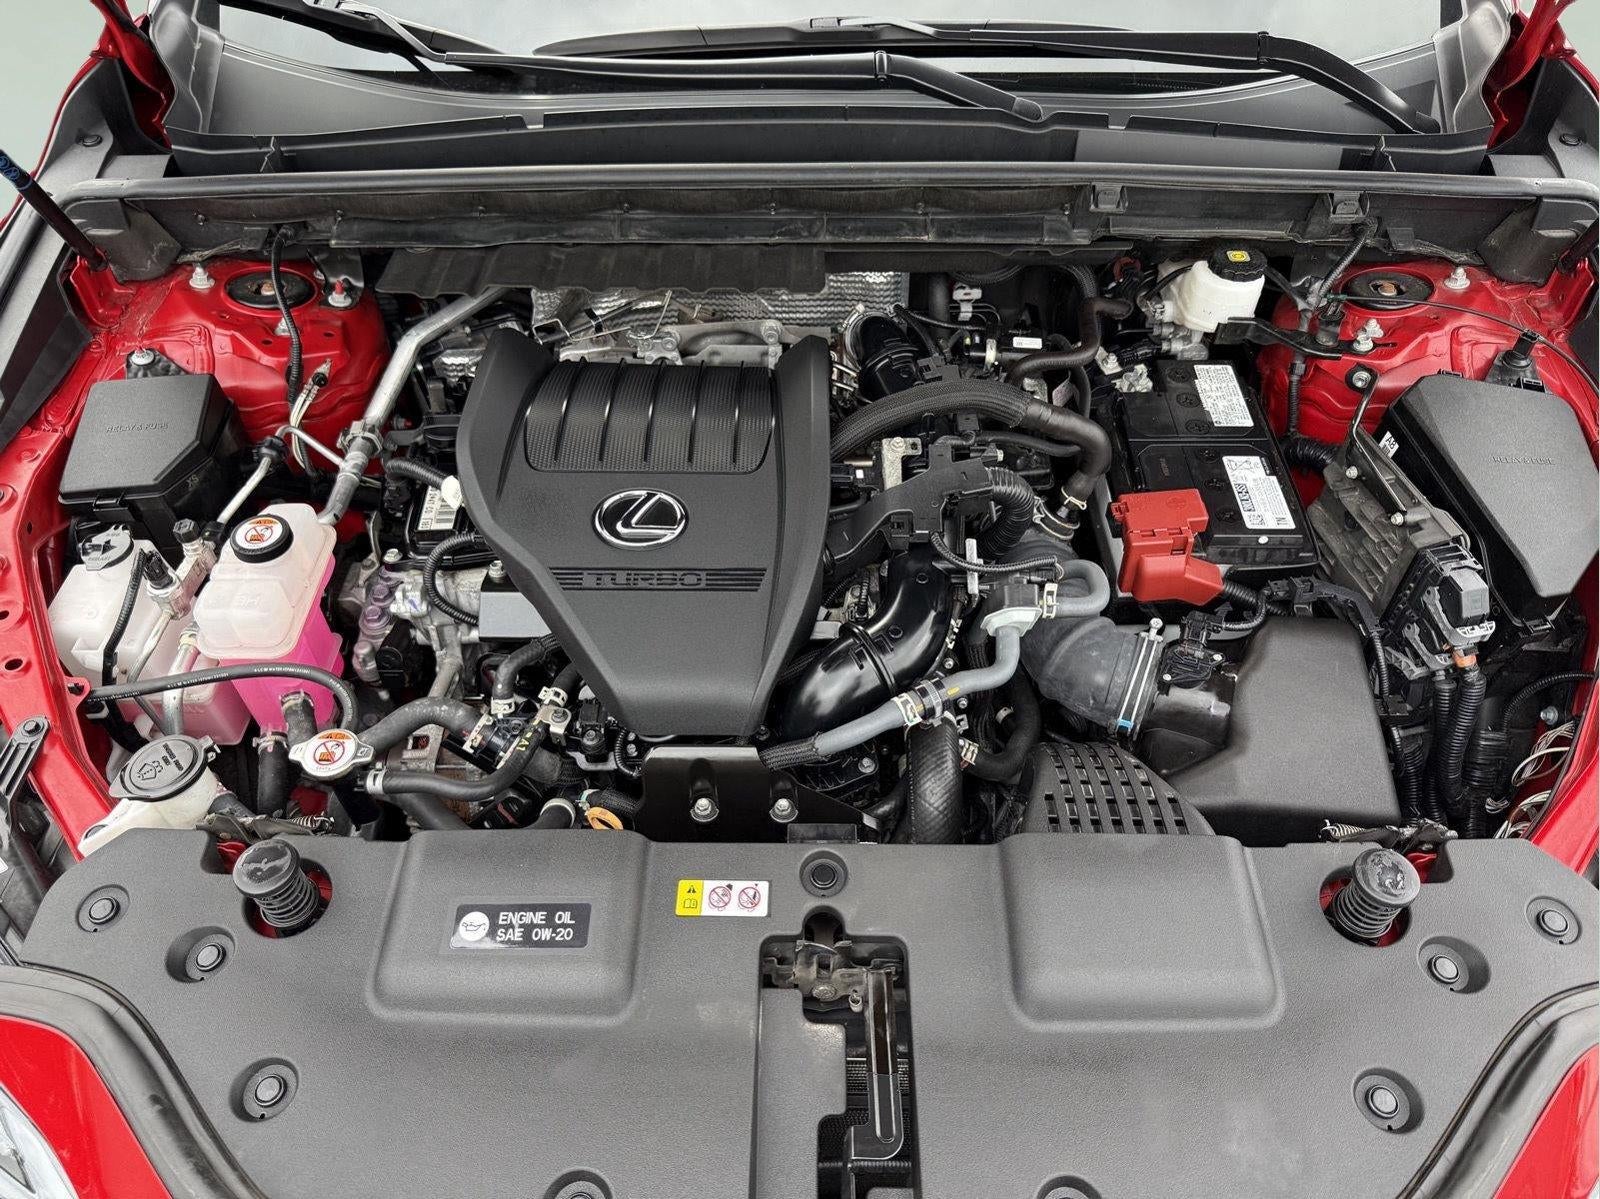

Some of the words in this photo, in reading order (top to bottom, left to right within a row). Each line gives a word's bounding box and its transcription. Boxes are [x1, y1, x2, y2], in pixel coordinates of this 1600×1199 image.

[106, 423, 136, 433] RELAY
[585, 572, 703, 587] TURBO
[498, 911, 548, 925] ENGINE
[554, 911, 576, 924] OIL
[496, 928, 524, 941] SAE
[531, 928, 574, 941] 0W-20
